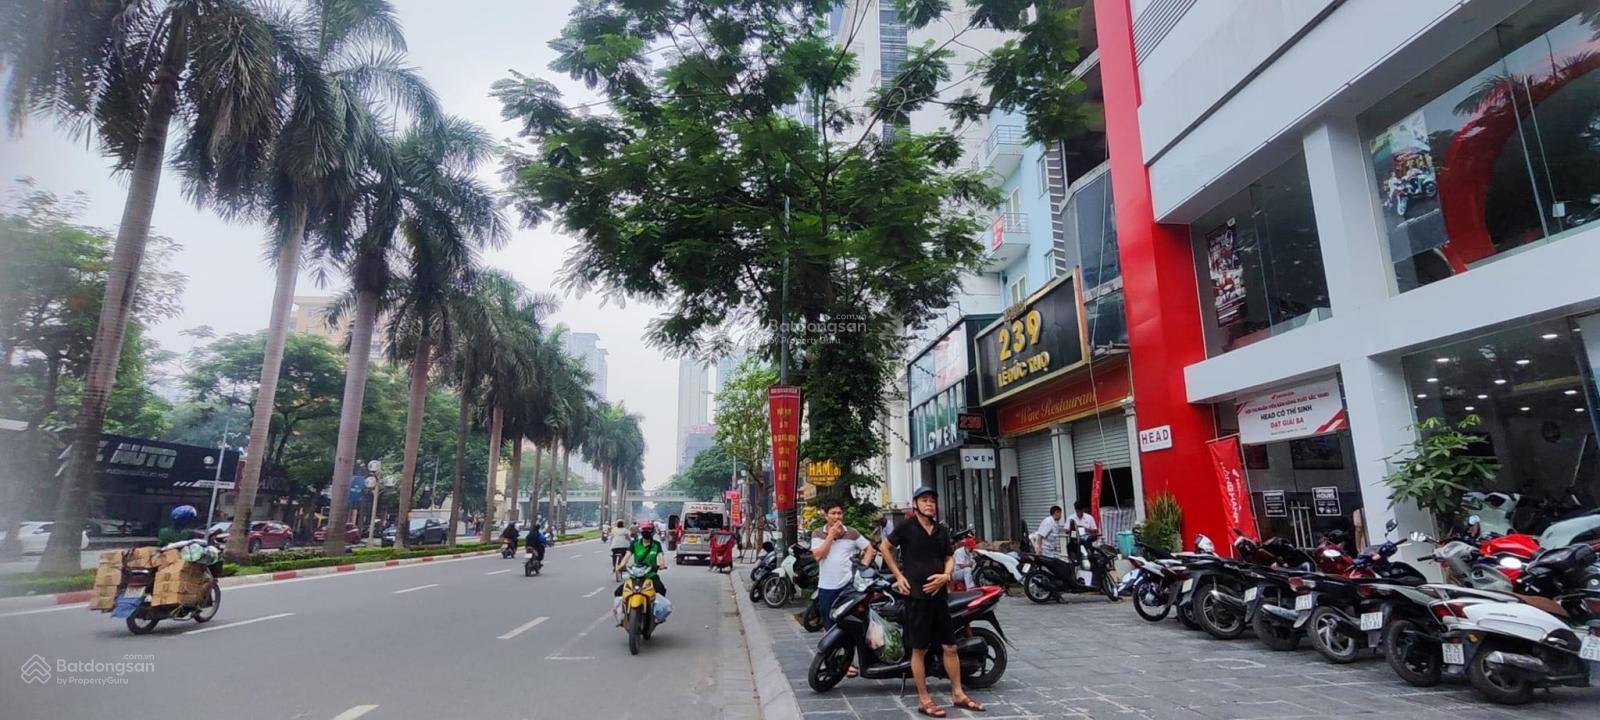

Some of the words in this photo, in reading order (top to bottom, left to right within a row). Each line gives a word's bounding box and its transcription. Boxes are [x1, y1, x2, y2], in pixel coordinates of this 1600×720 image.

[999, 310, 1042, 361] 239
[1261, 411, 1276, 420] HEAD
[1297, 404, 1313, 413] SINH
[1141, 429, 1169, 445] HEAD
[109, 442, 178, 470] AUTO
[964, 455, 994, 463] OWEN
